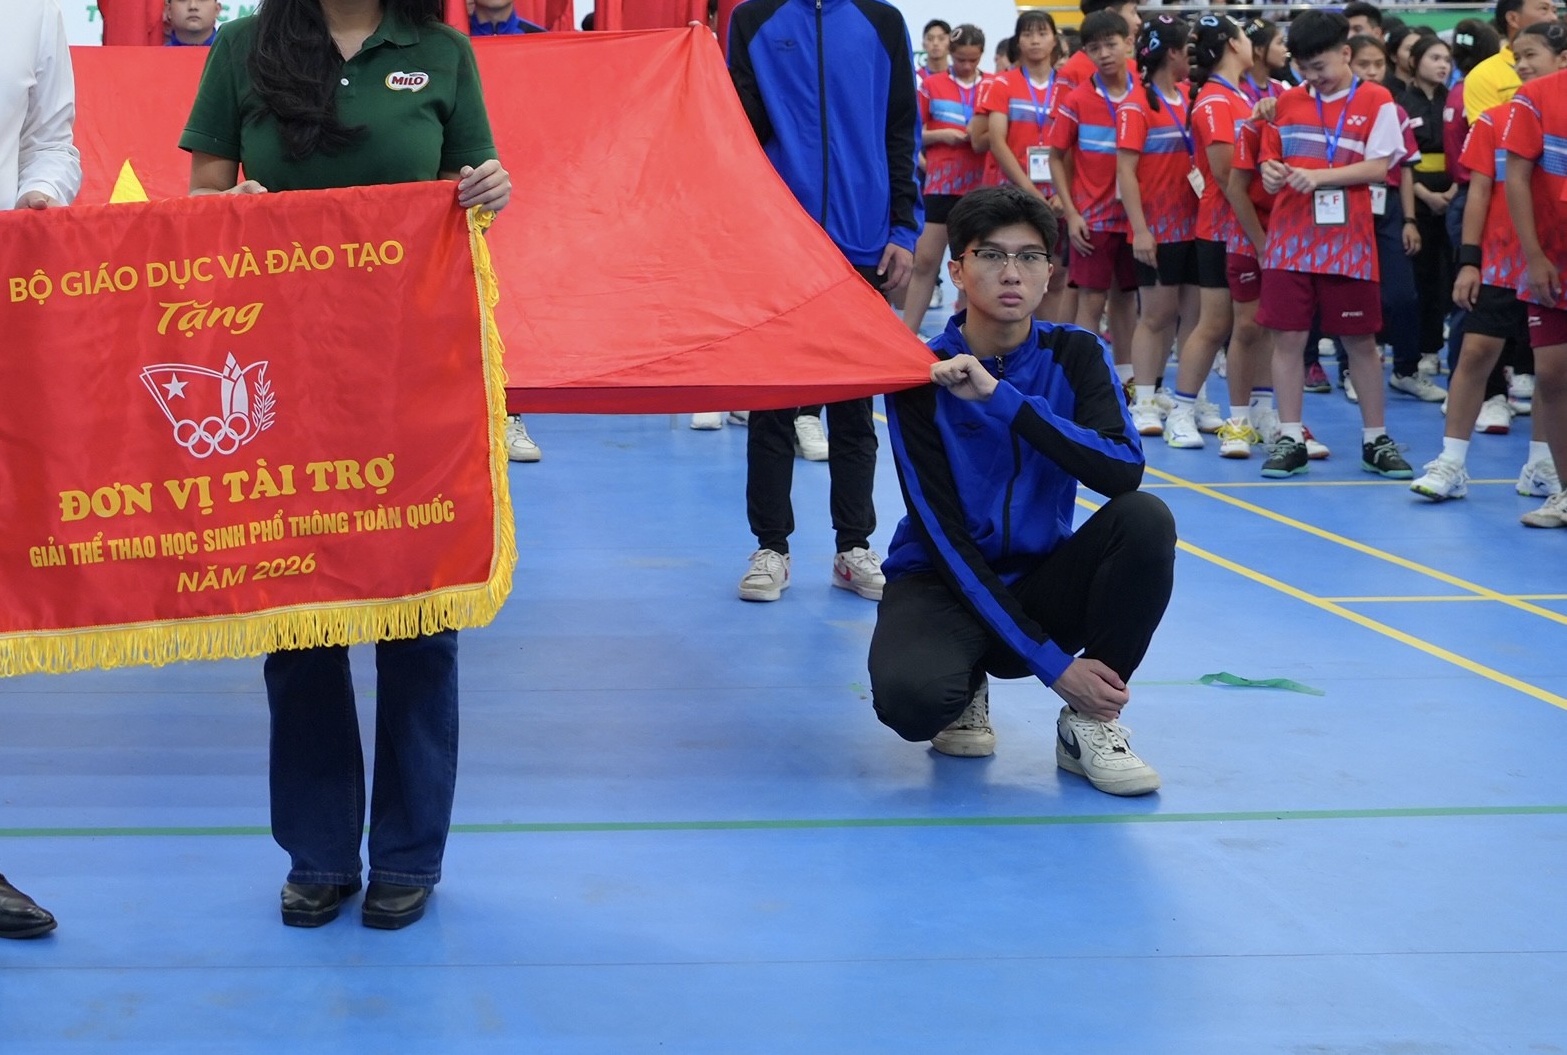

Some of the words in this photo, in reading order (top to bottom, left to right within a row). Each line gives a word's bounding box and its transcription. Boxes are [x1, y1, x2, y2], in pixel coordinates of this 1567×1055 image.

[391, 76, 424, 86] MILO
[1333, 194, 1340, 205] F
[9, 268, 54, 305] BỘ
[60, 262, 139, 297] GIÁO
[146, 257, 214, 290] DỤC
[216, 246, 261, 279] VÀ
[265, 241, 335, 275] ĐÀO
[340, 240, 405, 272] TẠO
[156, 299, 265, 338] Tặng
[59, 482, 153, 522] ĐƠN
[163, 476, 214, 515] VỊ
[222, 458, 297, 503] TÀI
[305, 453, 395, 495] TRỢ
[29, 536, 67, 568] GIẢI
[69, 531, 105, 565] THỂ
[107, 535, 156, 561] THAO
[160, 531, 198, 560] HỌC
[203, 523, 246, 552] SINH
[249, 509, 284, 545] PHỔ
[288, 509, 349, 537] THÔNG
[353, 503, 402, 533] TOÀN
[406, 493, 456, 529] QUỐC
[176, 564, 248, 593] NĂM
[252, 552, 317, 581] 2026
